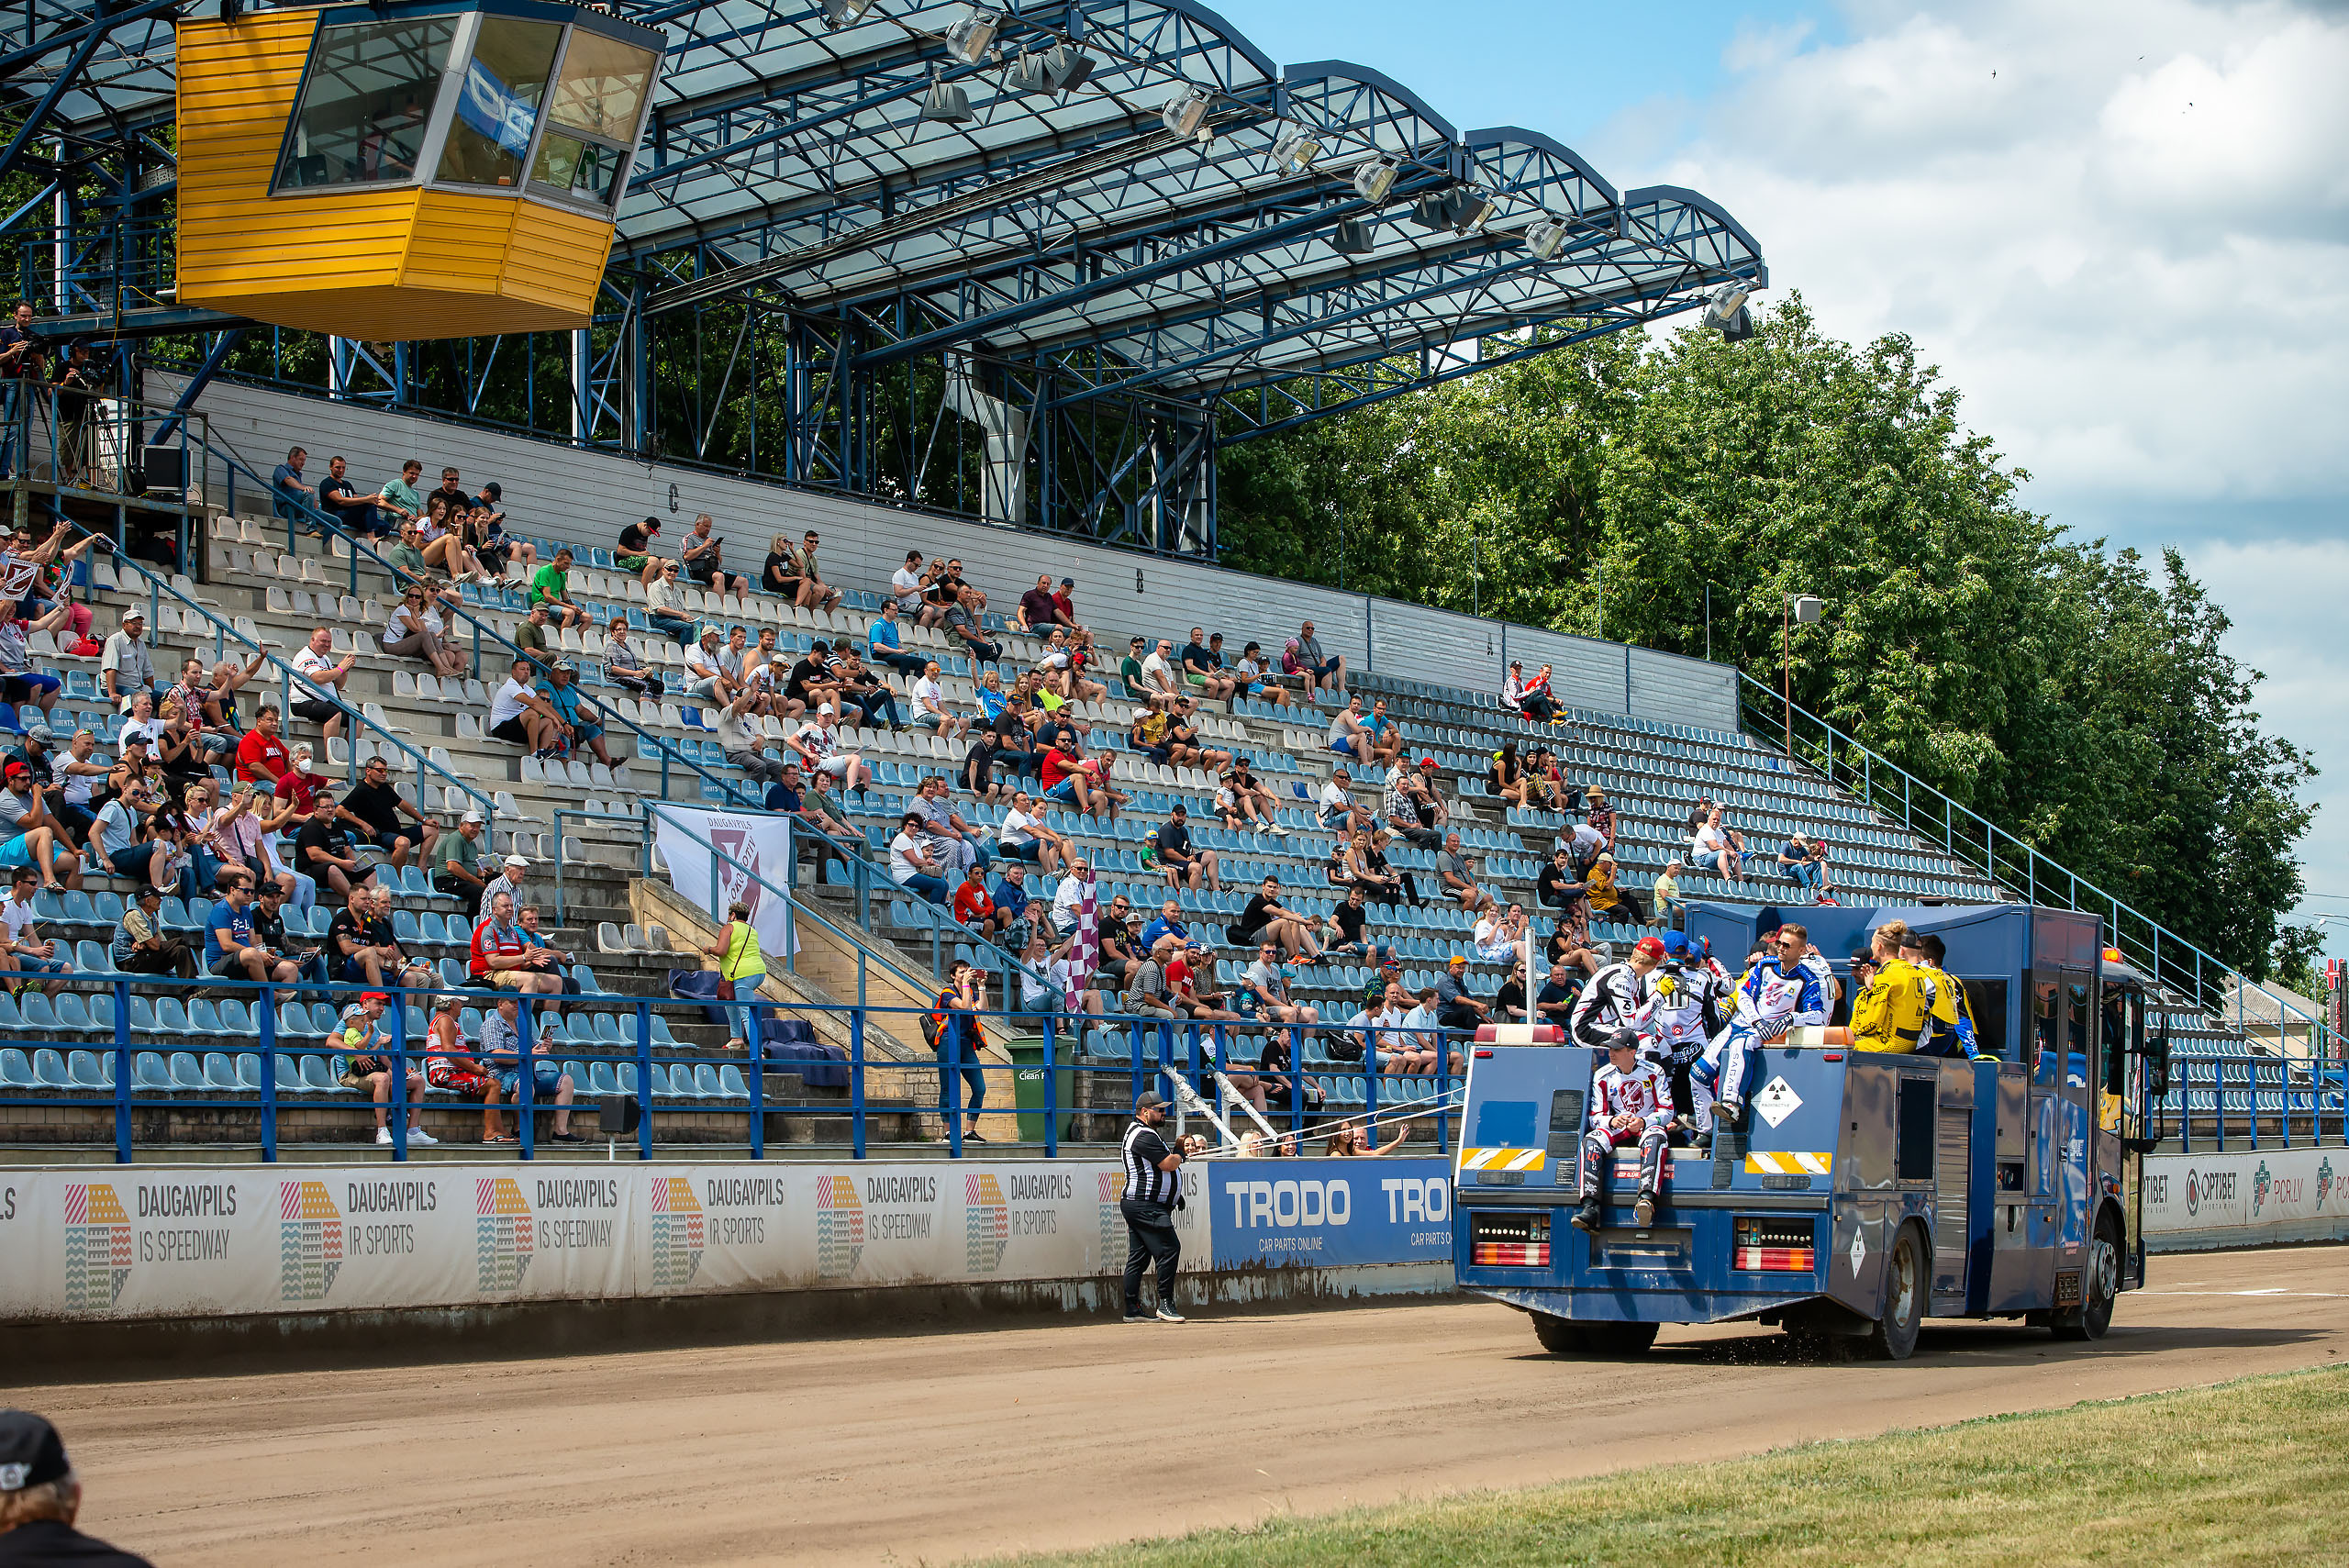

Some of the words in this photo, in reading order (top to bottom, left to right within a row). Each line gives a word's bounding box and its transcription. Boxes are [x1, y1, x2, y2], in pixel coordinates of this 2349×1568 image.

[668, 484, 679, 513] C
[707, 817, 753, 830] DAUGAVPILS
[1725, 1051, 1740, 1096] SAGARI
[139, 1184, 237, 1218] DAUGAVPILS
[349, 1182, 437, 1212] DAUGAVPILS
[538, 1179, 618, 1208] DAUGAVPILS
[707, 1178, 784, 1207] DAUGAVPILS
[867, 1176, 936, 1204] DAUGAVPILS
[1010, 1174, 1072, 1200] DAUGAVPILS
[1381, 1177, 1452, 1223] TRO
[2201, 1172, 2237, 1201] OPTIBET
[2274, 1177, 2304, 1205] PCR.LV
[2336, 1175, 2349, 1200] PC
[1226, 1179, 1351, 1228] TRODO
[539, 1220, 551, 1249] IS
[554, 1219, 612, 1249] SPEEDWAY
[709, 1218, 720, 1245] IR
[723, 1217, 764, 1245] SPORTS
[868, 1214, 879, 1240] IS
[882, 1213, 931, 1240] SPEEDWAY
[1012, 1211, 1021, 1236] IR
[1023, 1209, 1057, 1235] SPORTS
[139, 1231, 152, 1262] IS
[158, 1229, 229, 1262] SPEEDWAY
[350, 1226, 362, 1255] IR
[366, 1224, 414, 1255] SPORTS
[1259, 1239, 1273, 1251] CAR
[1275, 1238, 1297, 1251] PARTS
[1297, 1236, 1322, 1251] ONLINE
[1411, 1232, 1424, 1246] CAR
[1426, 1231, 1445, 1245] PARTS
